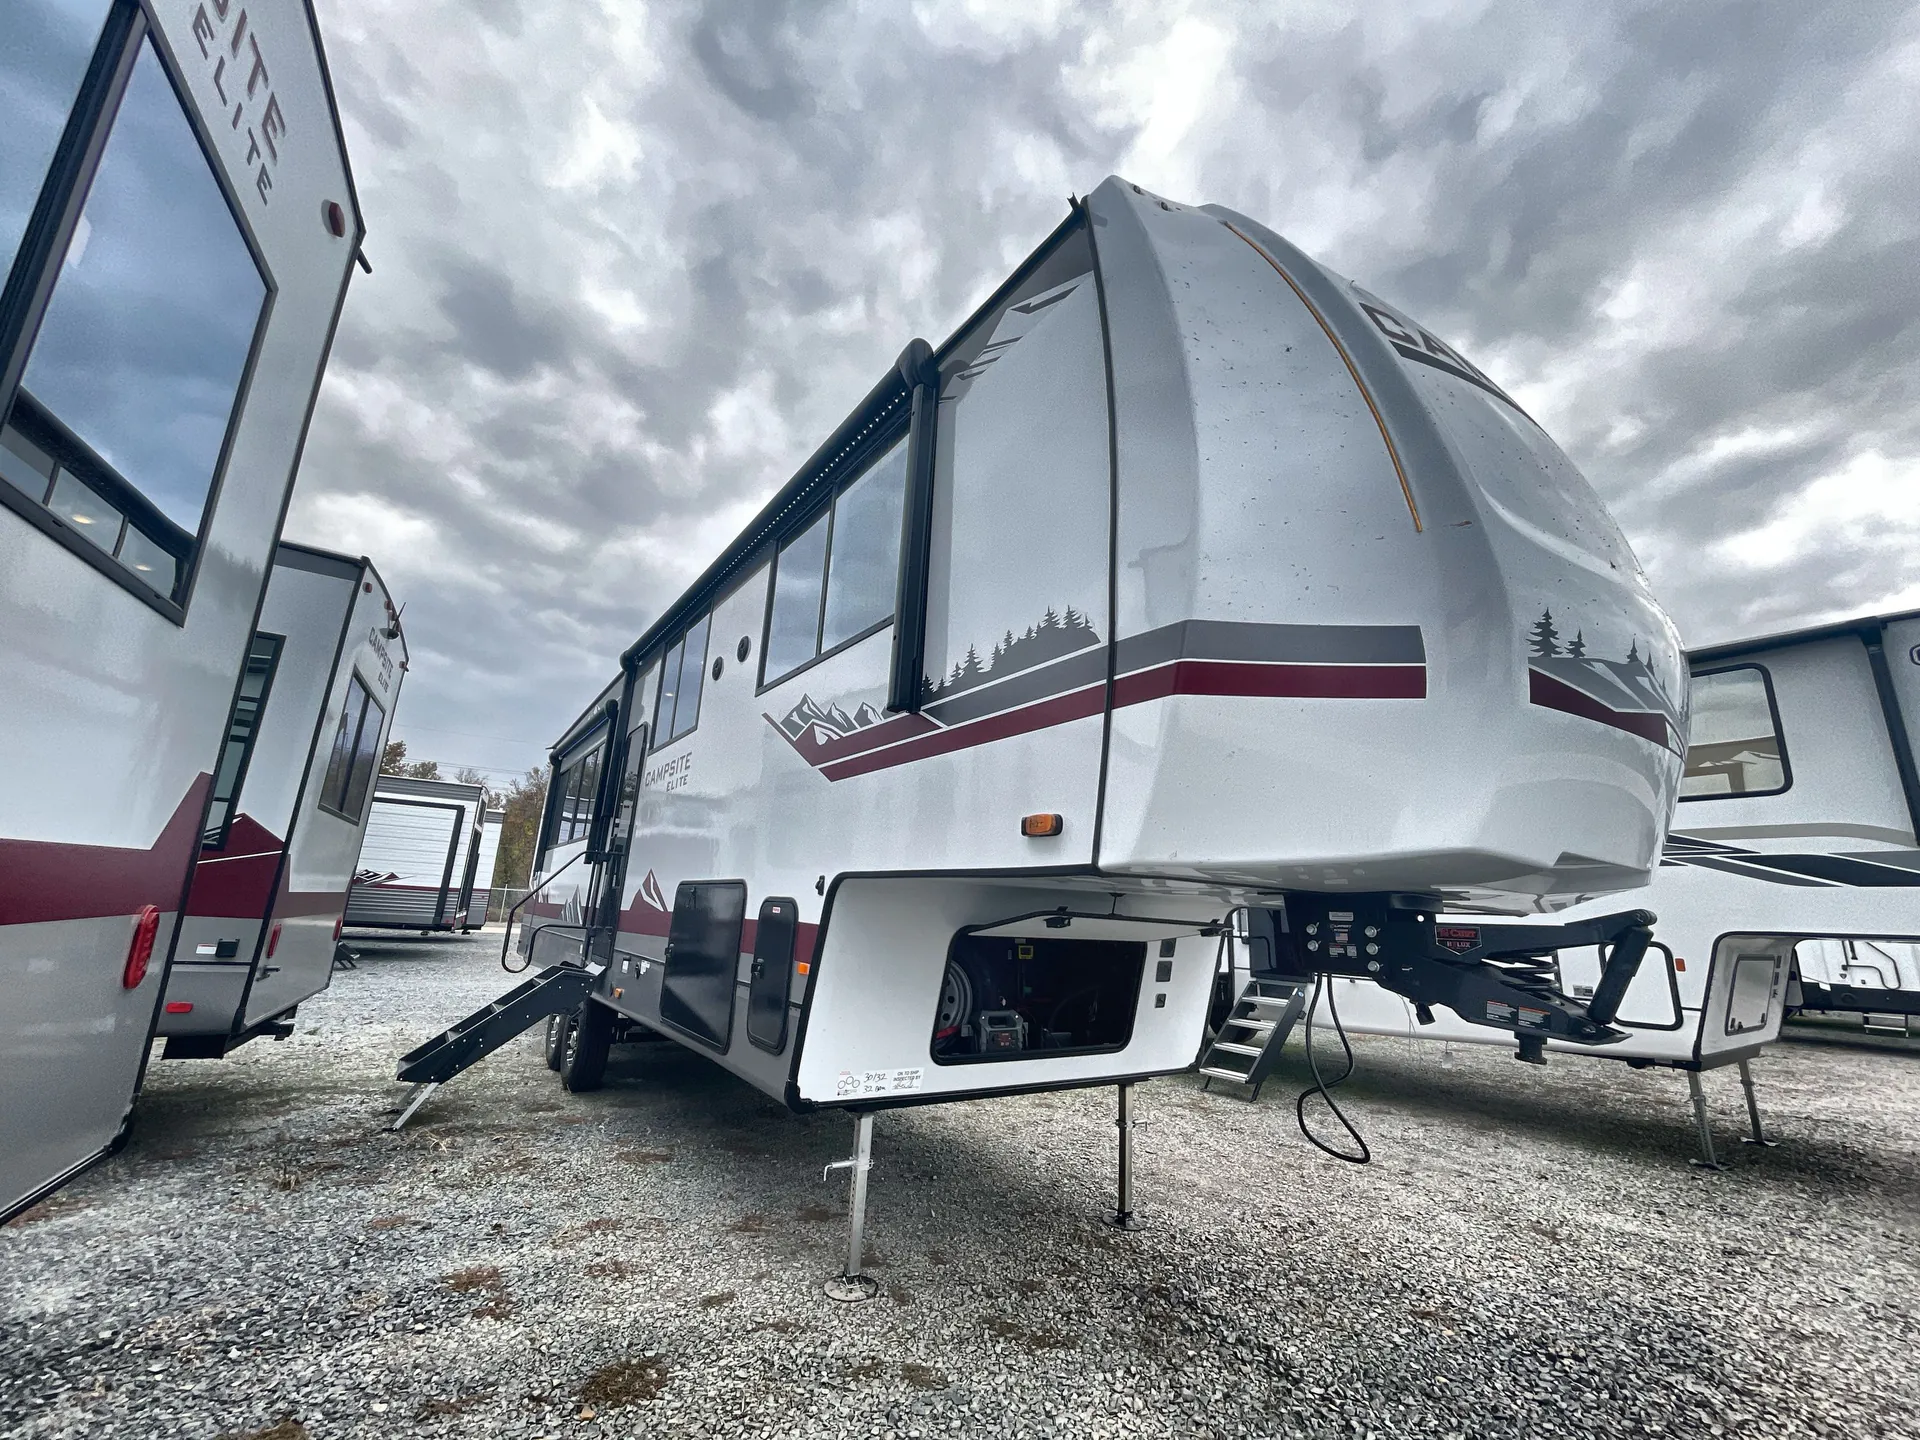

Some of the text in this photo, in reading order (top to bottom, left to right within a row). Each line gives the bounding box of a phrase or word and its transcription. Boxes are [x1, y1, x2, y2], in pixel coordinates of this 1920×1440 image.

[192, 4, 273, 206] ELITE
[369, 626, 394, 680] CAMPSITE
[378, 671, 389, 694] ELITE
[645, 751, 692, 787] CAMPSITE
[666, 774, 688, 792] ELITE
